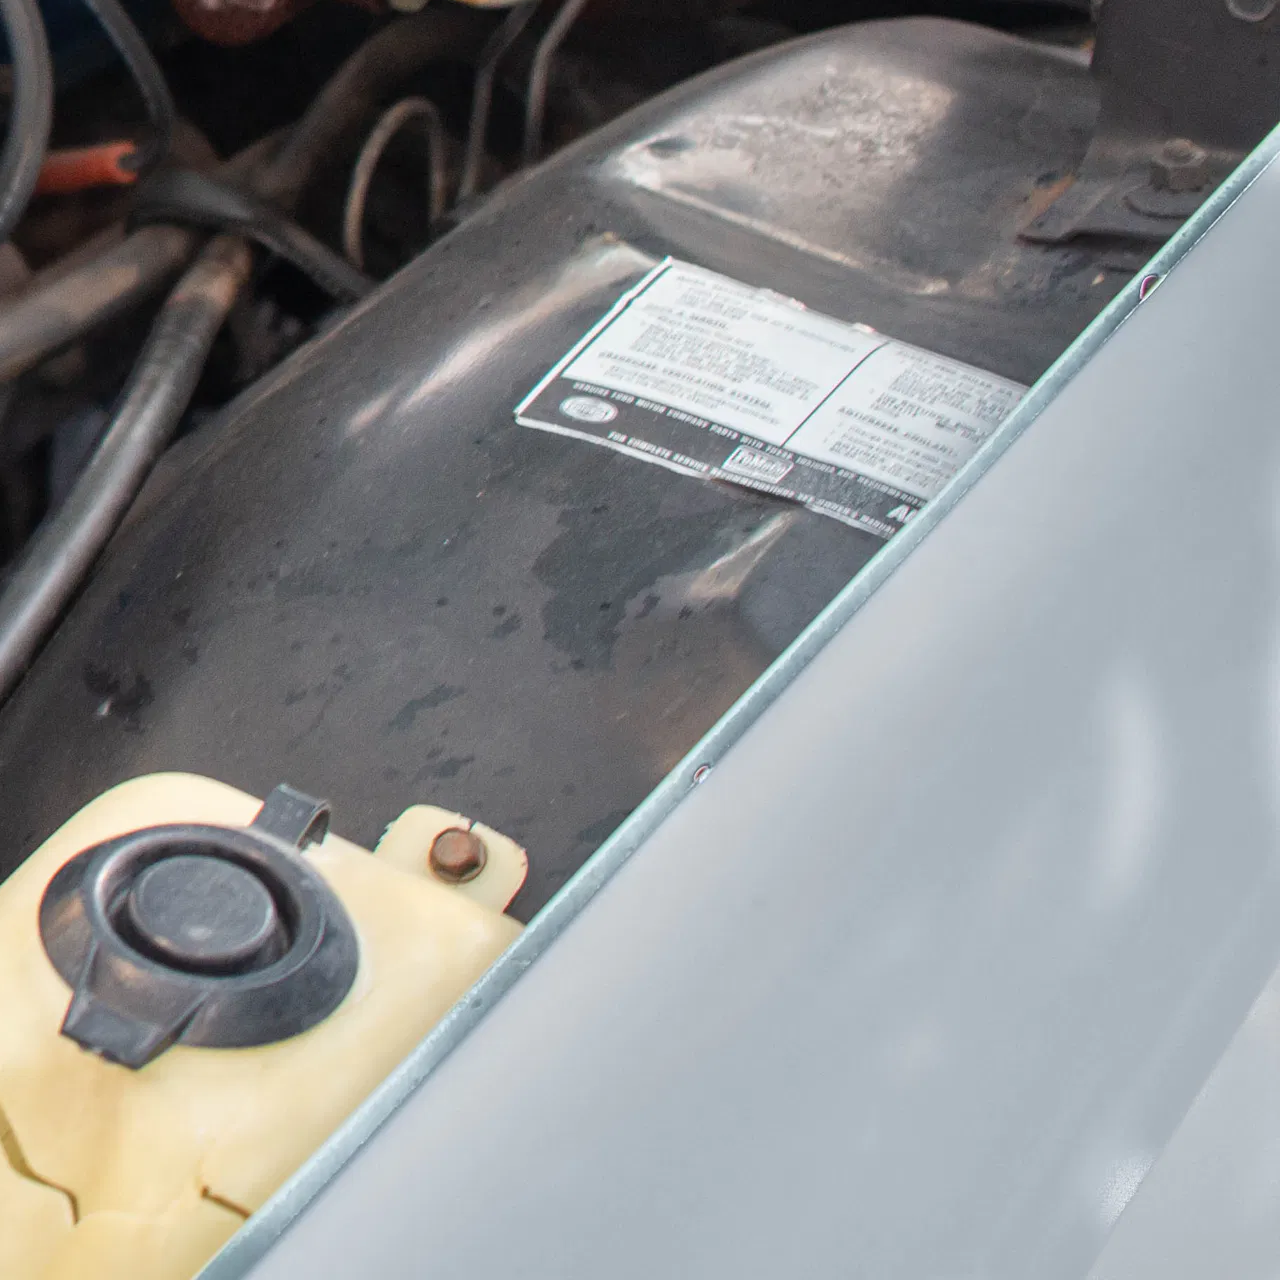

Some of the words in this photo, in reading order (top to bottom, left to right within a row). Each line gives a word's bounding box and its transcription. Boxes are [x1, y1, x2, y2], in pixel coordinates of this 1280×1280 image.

[571, 381, 611, 396] GENUINE
[609, 391, 636, 404] FORD
[633, 398, 668, 414] MOTOR
[665, 408, 710, 429] COMPANY
[707, 424, 741, 440] PARTS
[737, 435, 765, 449] WITH
[606, 430, 629, 443] FOR
[625, 437, 673, 459] COMPLETE
[669, 453, 711, 472] SERVICE
